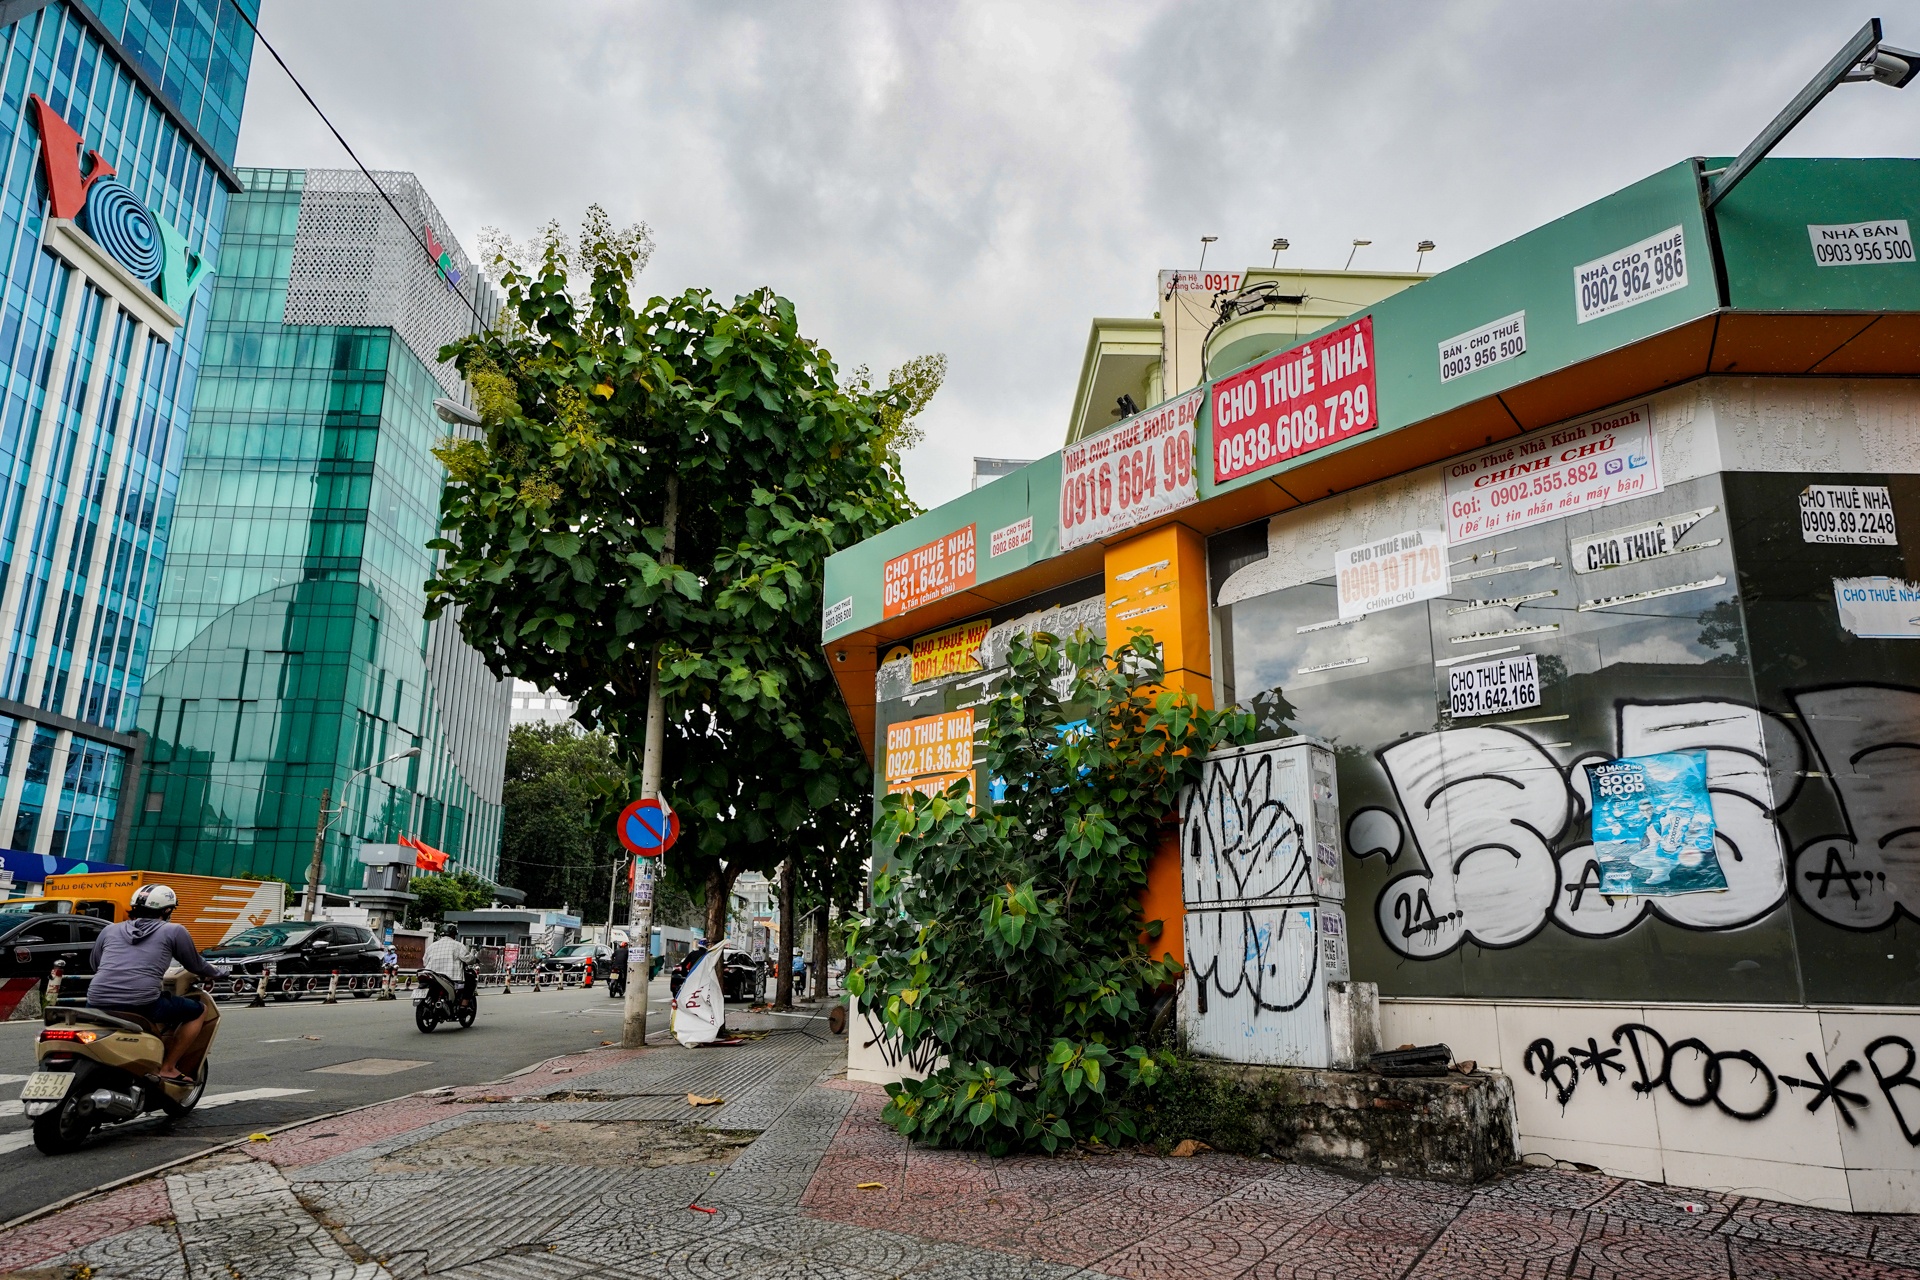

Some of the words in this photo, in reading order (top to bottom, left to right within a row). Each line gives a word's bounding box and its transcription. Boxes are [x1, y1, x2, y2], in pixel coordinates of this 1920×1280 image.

[1816, 243, 1852, 262] 0903
[1854, 241, 1882, 261] 956
[1884, 239, 1912, 260] 500
[1822, 227, 1859, 239] NHÀ
[1862, 225, 1898, 237] BÁN
[1581, 264, 1609, 284] NHÀ
[1612, 253, 1641, 272] CHO
[1644, 233, 1682, 259] THUÊ
[1204, 273, 1241, 291] 0917
[1582, 274, 1619, 311] 0902
[1622, 261, 1651, 297] 962
[1654, 248, 1684, 285] 986
[1443, 344, 1462, 360] BÁN
[1470, 334, 1490, 349] CHO
[1492, 320, 1519, 340] THUÊ
[1443, 355, 1471, 379] 0903
[1474, 346, 1497, 367] 956
[1500, 336, 1523, 358] 500
[1218, 379, 1257, 428] CHO
[1261, 345, 1315, 410] THUÊ
[1321, 323, 1368, 387] NHÀ
[1065, 443, 1087, 475] NHÀ
[1089, 438, 1111, 464] CHO
[1113, 421, 1141, 453] THUÊ
[1143, 408, 1175, 439] HOẶC
[1219, 384, 1370, 475] 0938.608.739
[1451, 463, 1477, 478] Cho
[1480, 448, 1515, 466] Thuê
[1519, 438, 1547, 457] Nhà
[1551, 426, 1587, 447] Kinh
[1591, 411, 1641, 435] Doanh
[1063, 462, 1112, 529] 0916
[1118, 446, 1157, 510] 664
[1163, 430, 1191, 492] 99
[1473, 455, 1553, 488] CHÍNH
[1560, 434, 1616, 462] CHỦ
[1452, 498, 1481, 519] Gọi:
[1491, 461, 1599, 508] 0902.555.882
[1459, 516, 1482, 538] (Để
[1486, 513, 1500, 531] lại
[1506, 507, 1521, 523] tin
[1527, 498, 1553, 517] nhắn
[1559, 491, 1580, 507] nếu
[1586, 485, 1611, 504] máy
[1617, 473, 1645, 495] bận)
[1800, 490, 1825, 508] CHO
[1827, 487, 1861, 509] THUÊ
[1863, 488, 1891, 509] NHÀ
[992, 540, 1007, 555] 0902
[1020, 529, 1032, 543] 447
[1006, 526, 1017, 536] CHO
[1802, 511, 1894, 534] 0909.89.2248
[1816, 534, 1854, 543] Chính
[1859, 535, 1885, 544] Chủ
[885, 557, 909, 582] CHO
[913, 539, 944, 570] THUÊ
[948, 526, 974, 556] NHÀ
[1350, 547, 1371, 564] CHO
[1373, 537, 1399, 558] THUÊ
[1401, 530, 1423, 550] NHÀ
[1587, 540, 1620, 571] CHO
[1623, 521, 1668, 562] THUÊ
[885, 548, 975, 606] 0931.642.166
[1341, 562, 1380, 604] 0909
[1382, 556, 1400, 593] 19
[1400, 550, 1417, 588] 77
[1420, 544, 1441, 583] 29
[1843, 588, 1866, 602] CHO
[1869, 585, 1897, 602] THUÊ
[1366, 596, 1394, 610] CHÍNH
[1395, 588, 1415, 603] CHỦ
[913, 639, 934, 659] CHO
[938, 627, 965, 652] THUÊ
[966, 620, 989, 644] NHÀ
[1451, 670, 1474, 691] CHO
[1476, 661, 1506, 688] THUÊ
[1509, 656, 1534, 683] NHÀ
[1452, 683, 1536, 713] 0931.642.166
[888, 728, 911, 750] CHO
[914, 716, 944, 746] THUÊ
[947, 711, 972, 740] NHÀ
[887, 740, 971, 778] 0922.16.36.36
[1599, 773, 1644, 786] GOOD
[1600, 783, 1645, 797] MOOD
[35, 1074, 67, 1085] 59-T1
